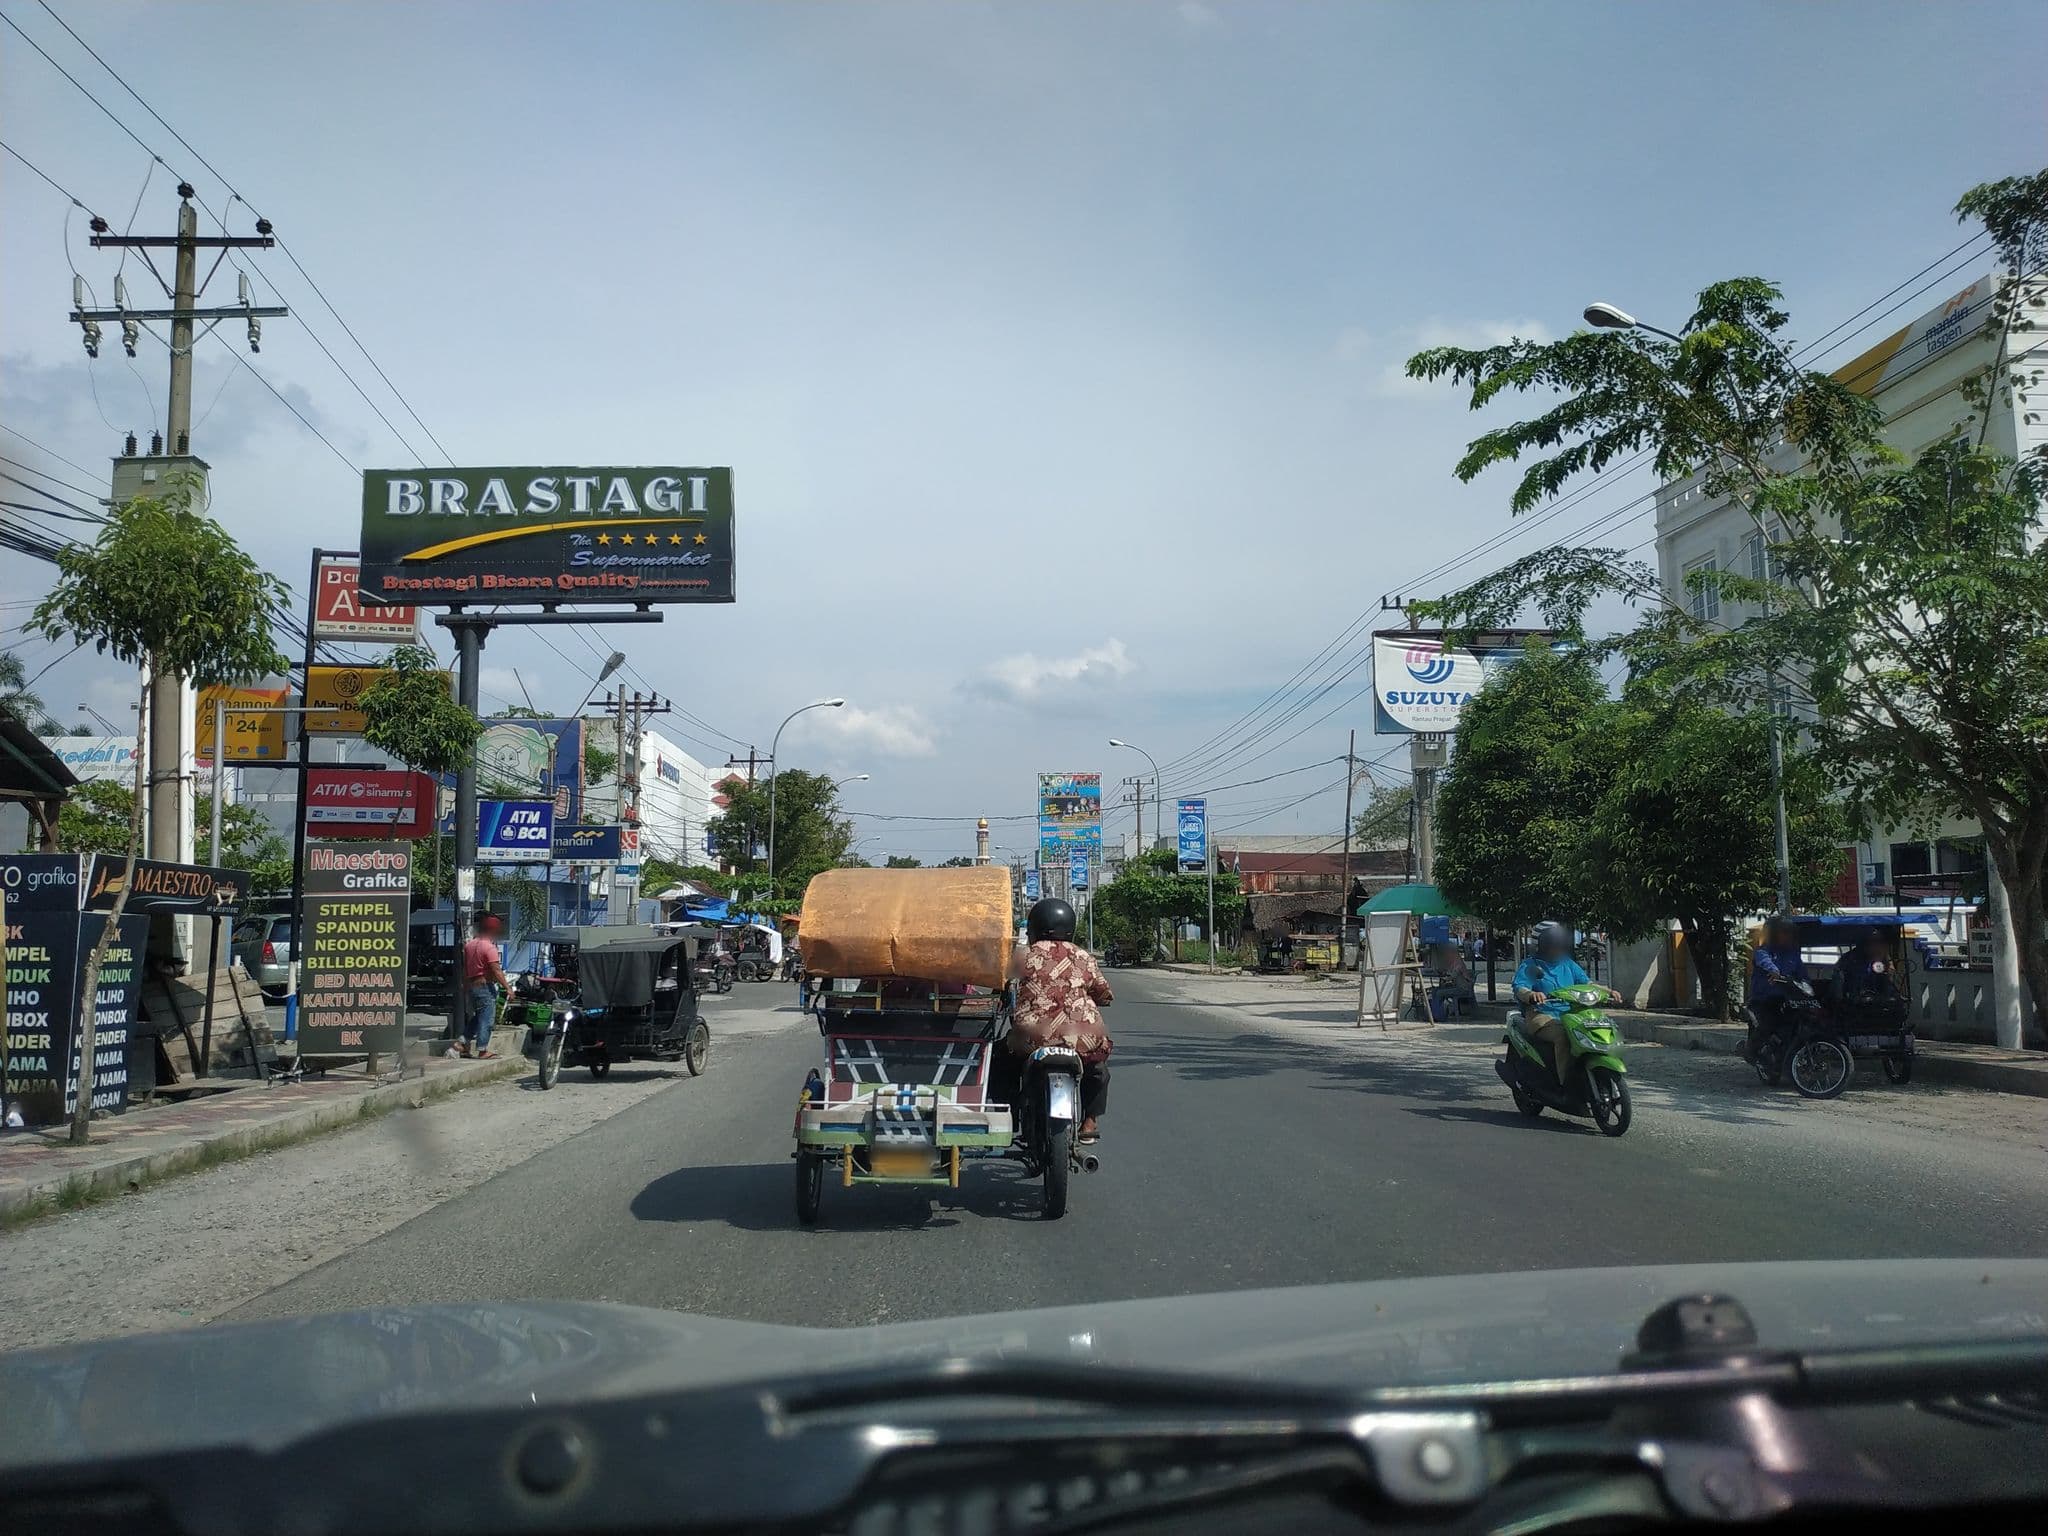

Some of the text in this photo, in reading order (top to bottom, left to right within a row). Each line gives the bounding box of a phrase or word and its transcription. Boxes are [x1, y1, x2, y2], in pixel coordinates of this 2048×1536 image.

[1927, 325, 1963, 353] taspen
[385, 475, 709, 517] BRASTAGI
[570, 534, 592, 547] The
[570, 549, 712, 568] Supermarket
[382, 575, 477, 591] Brastagi
[482, 574, 553, 588] Bicara
[204, 697, 272, 711] Dnamon
[1386, 691, 1473, 705] SUZUYA
[236, 720, 257, 733] 24
[312, 783, 348, 796] ATM
[509, 811, 541, 824] ATM
[517, 827, 547, 840] BCA
[553, 836, 594, 847] mandiri
[310, 849, 408, 871] Maestro
[28, 866, 77, 891] grafika
[135, 867, 212, 897] MAESTRO
[343, 874, 408, 889] Grafika
[319, 904, 394, 917] STEMPEL
[315, 921, 396, 934] SPANDUK
[315, 939, 396, 952] NEONBOX
[89, 946, 133, 963] SEMPEL
[307, 956, 402, 969] BILLBOARD
[314, 974, 394, 989] BED NAMA
[303, 992, 403, 1008] KARTU NAMA
[308, 1012, 397, 1027] UNDANGAN
[341, 1031, 363, 1046] BK
[95, 1051, 123, 1067] NAMA
[99, 1070, 127, 1087] NAMA
